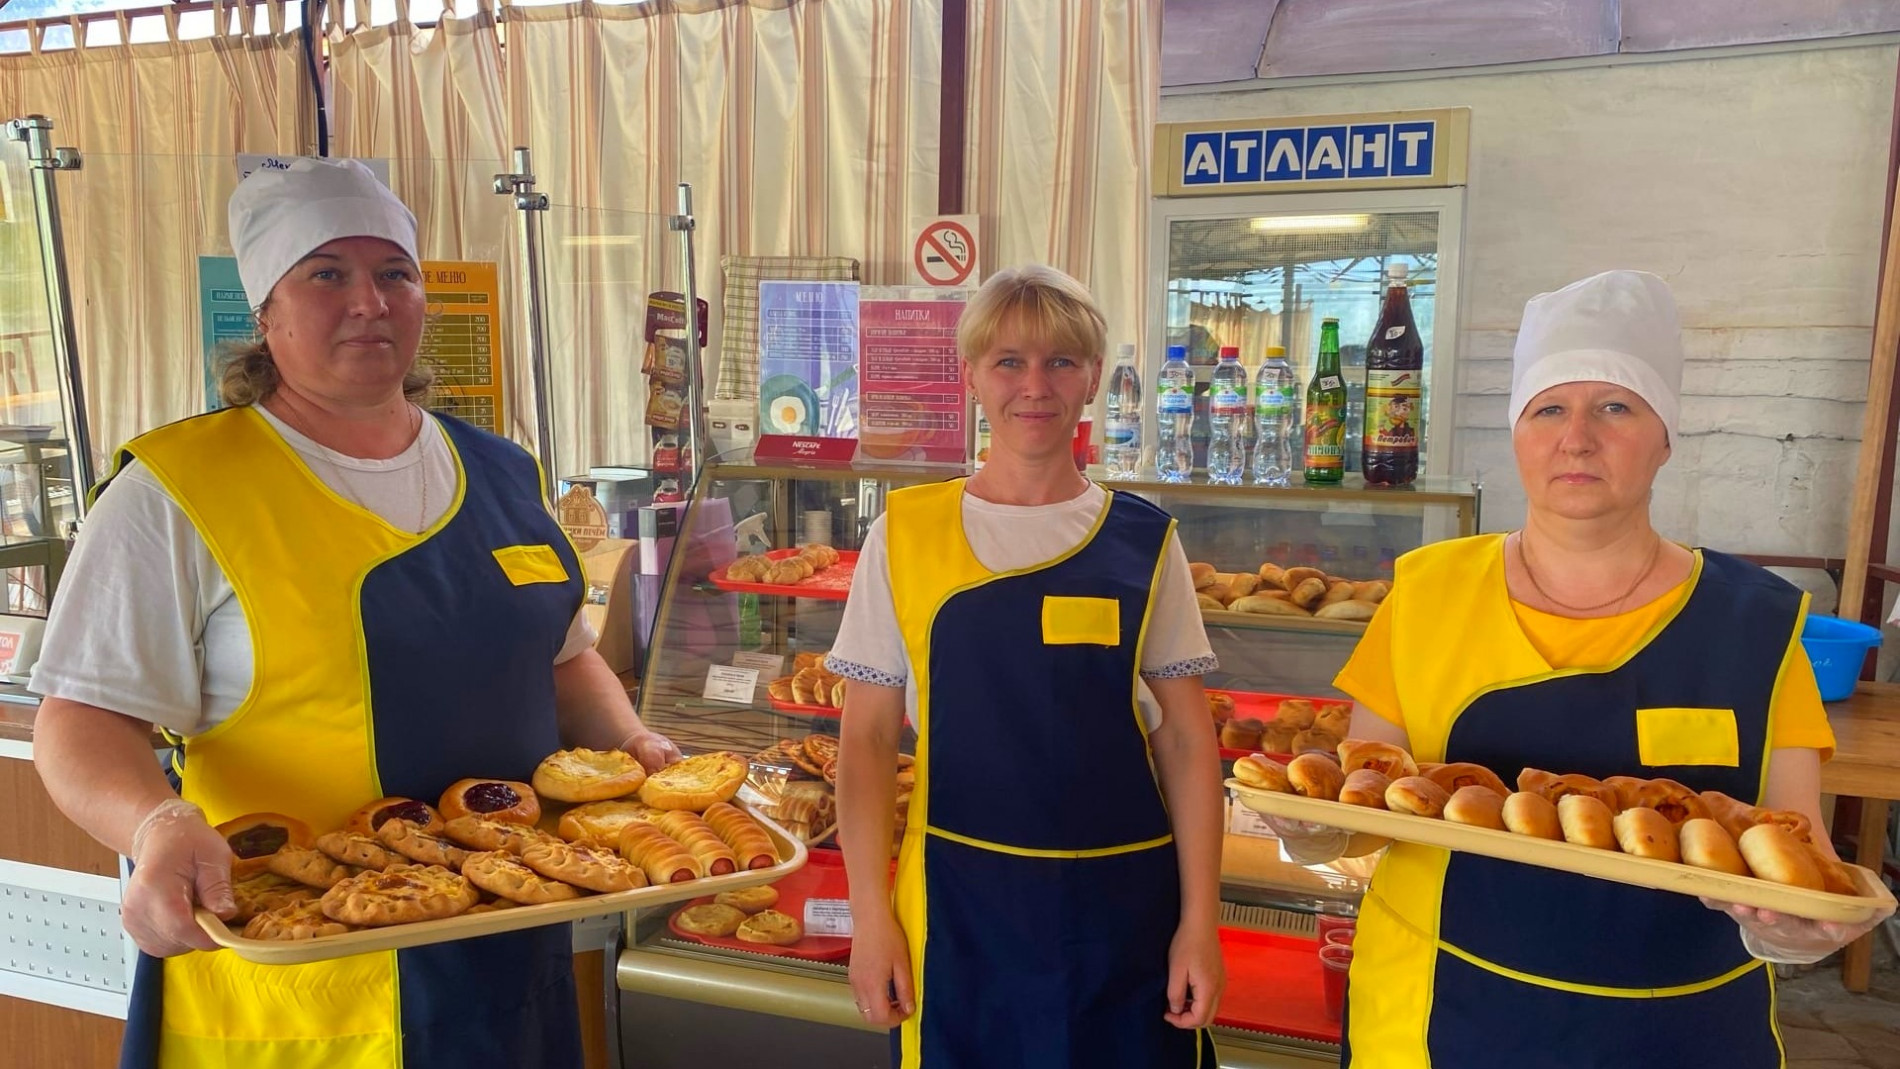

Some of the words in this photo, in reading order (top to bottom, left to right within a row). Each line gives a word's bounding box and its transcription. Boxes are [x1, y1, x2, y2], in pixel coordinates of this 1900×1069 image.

[1186, 131, 1428, 176] АТЛАНТ
[436, 271, 467, 284] МЕНЮ
[895, 309, 930, 321] НАПИТКИ
